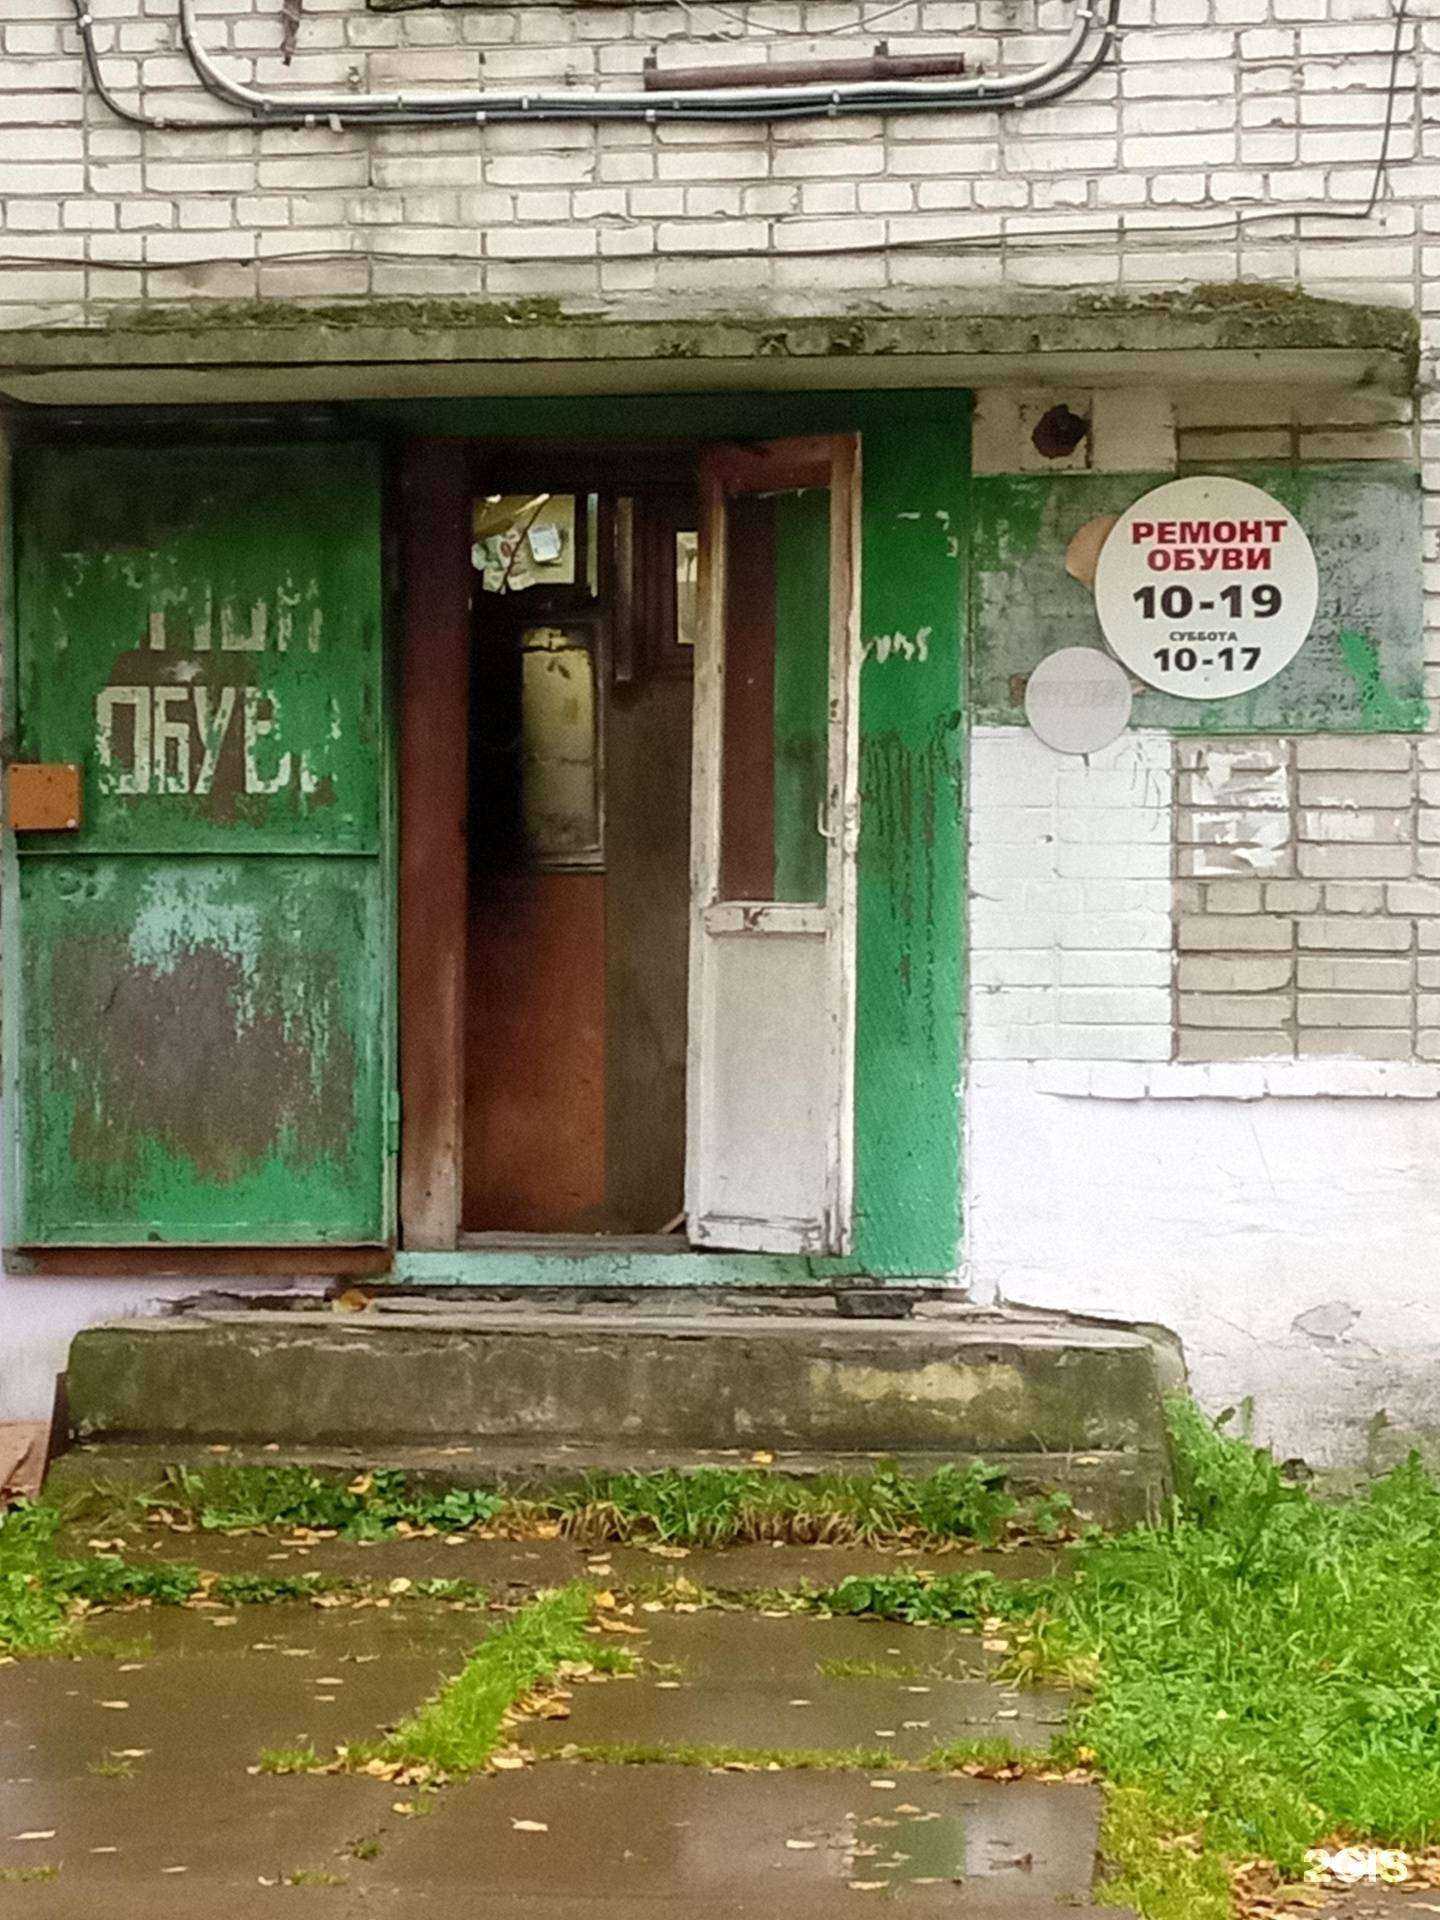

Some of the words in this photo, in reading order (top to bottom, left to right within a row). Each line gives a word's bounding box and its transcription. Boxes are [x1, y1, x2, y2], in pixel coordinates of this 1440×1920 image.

[1132, 520, 1288, 544] РЕМОНТ
[1147, 548, 1272, 571] ОБУВИ
[1132, 584, 1282, 619] 10-19
[1169, 631, 1238, 642] СУББОТА
[1153, 647, 1261, 672] 10-17
